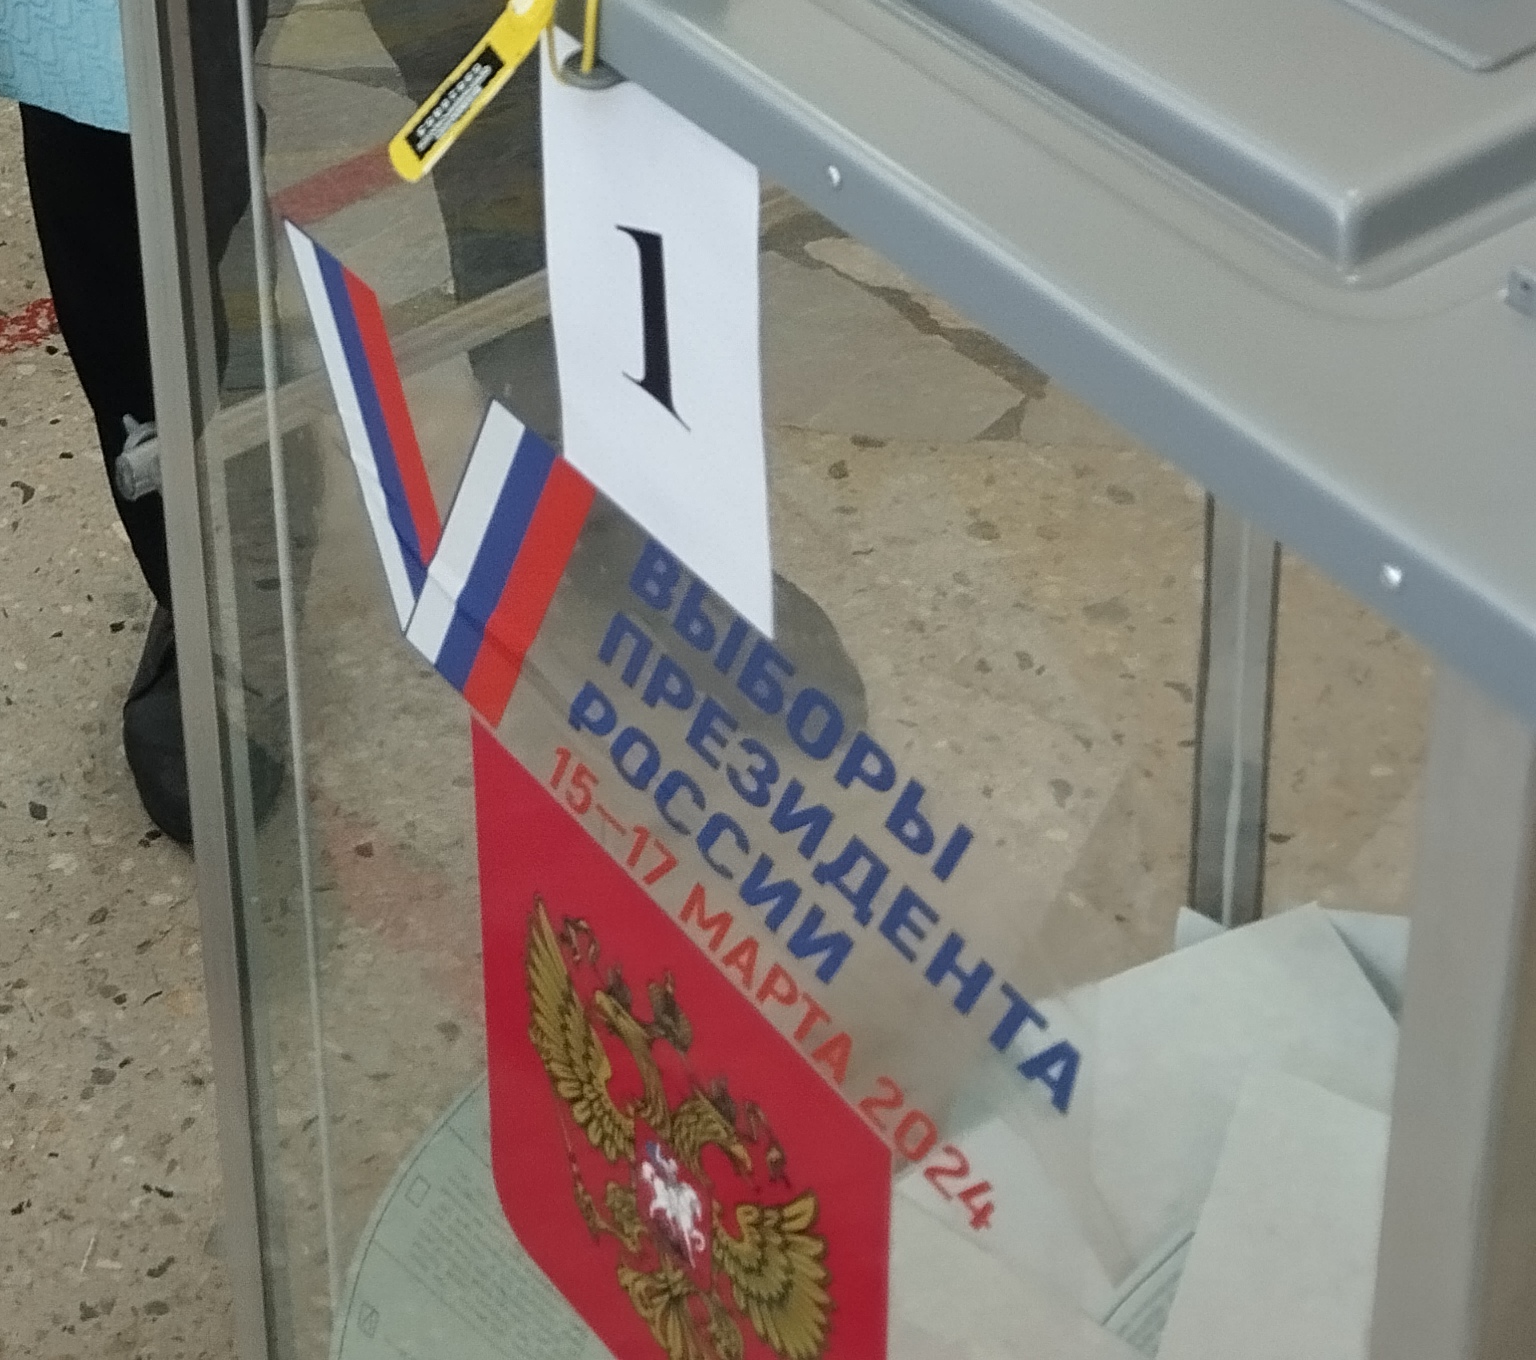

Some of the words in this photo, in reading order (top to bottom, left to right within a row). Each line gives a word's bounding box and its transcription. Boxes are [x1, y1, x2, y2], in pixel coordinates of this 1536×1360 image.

[614, 224, 691, 433] 1
[568, 680, 855, 986] РОССИИ
[598, 611, 1081, 1117] ПРЕЗИДЕНТА
[629, 539, 974, 883] ВЫБОРЫ
[679, 881, 854, 1083] МАРТА
[858, 1075, 995, 1233] 2024
